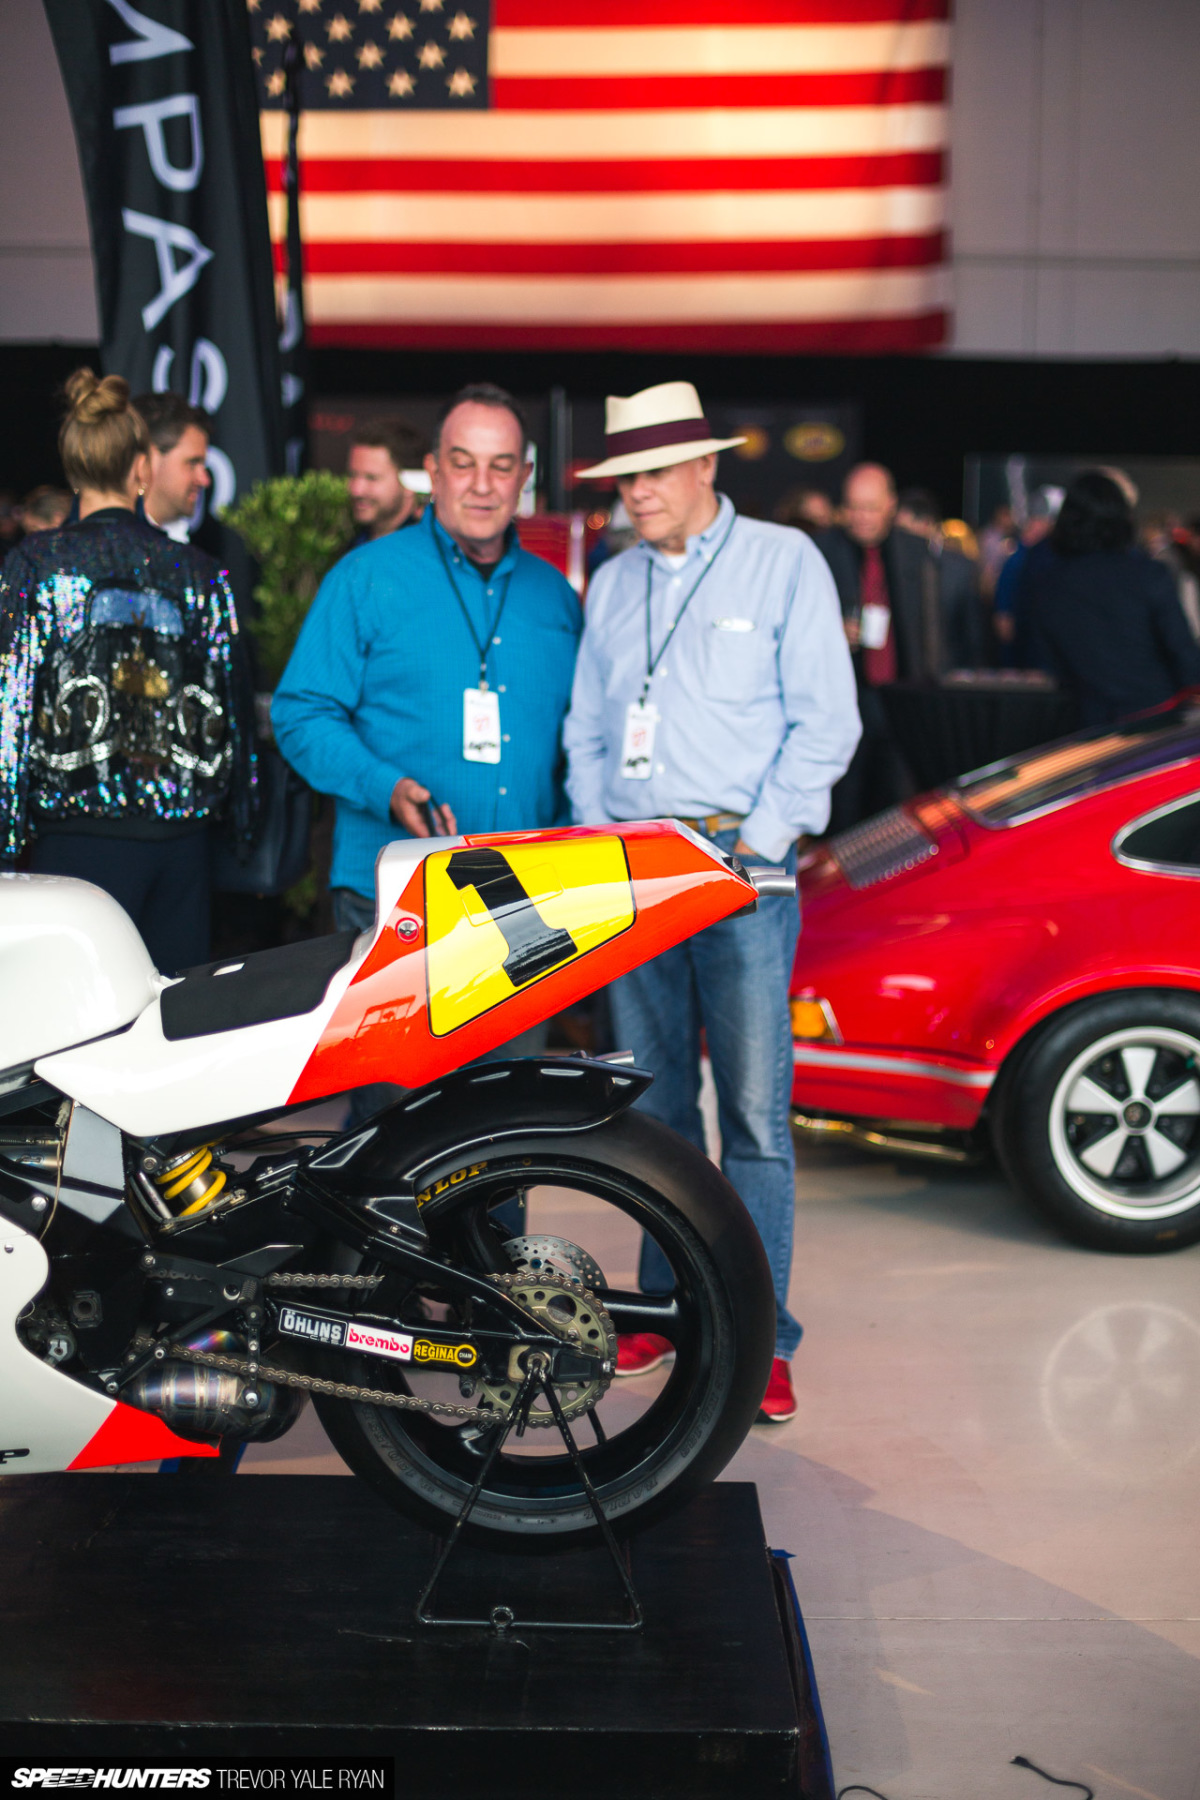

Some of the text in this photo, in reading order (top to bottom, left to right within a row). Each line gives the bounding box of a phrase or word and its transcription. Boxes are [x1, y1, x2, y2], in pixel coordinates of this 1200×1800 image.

[445, 848, 578, 987] 1
[284, 1310, 342, 1340] ÖHLINS
[349, 1328, 410, 1354] brembo
[414, 1344, 455, 1361] REGINA
